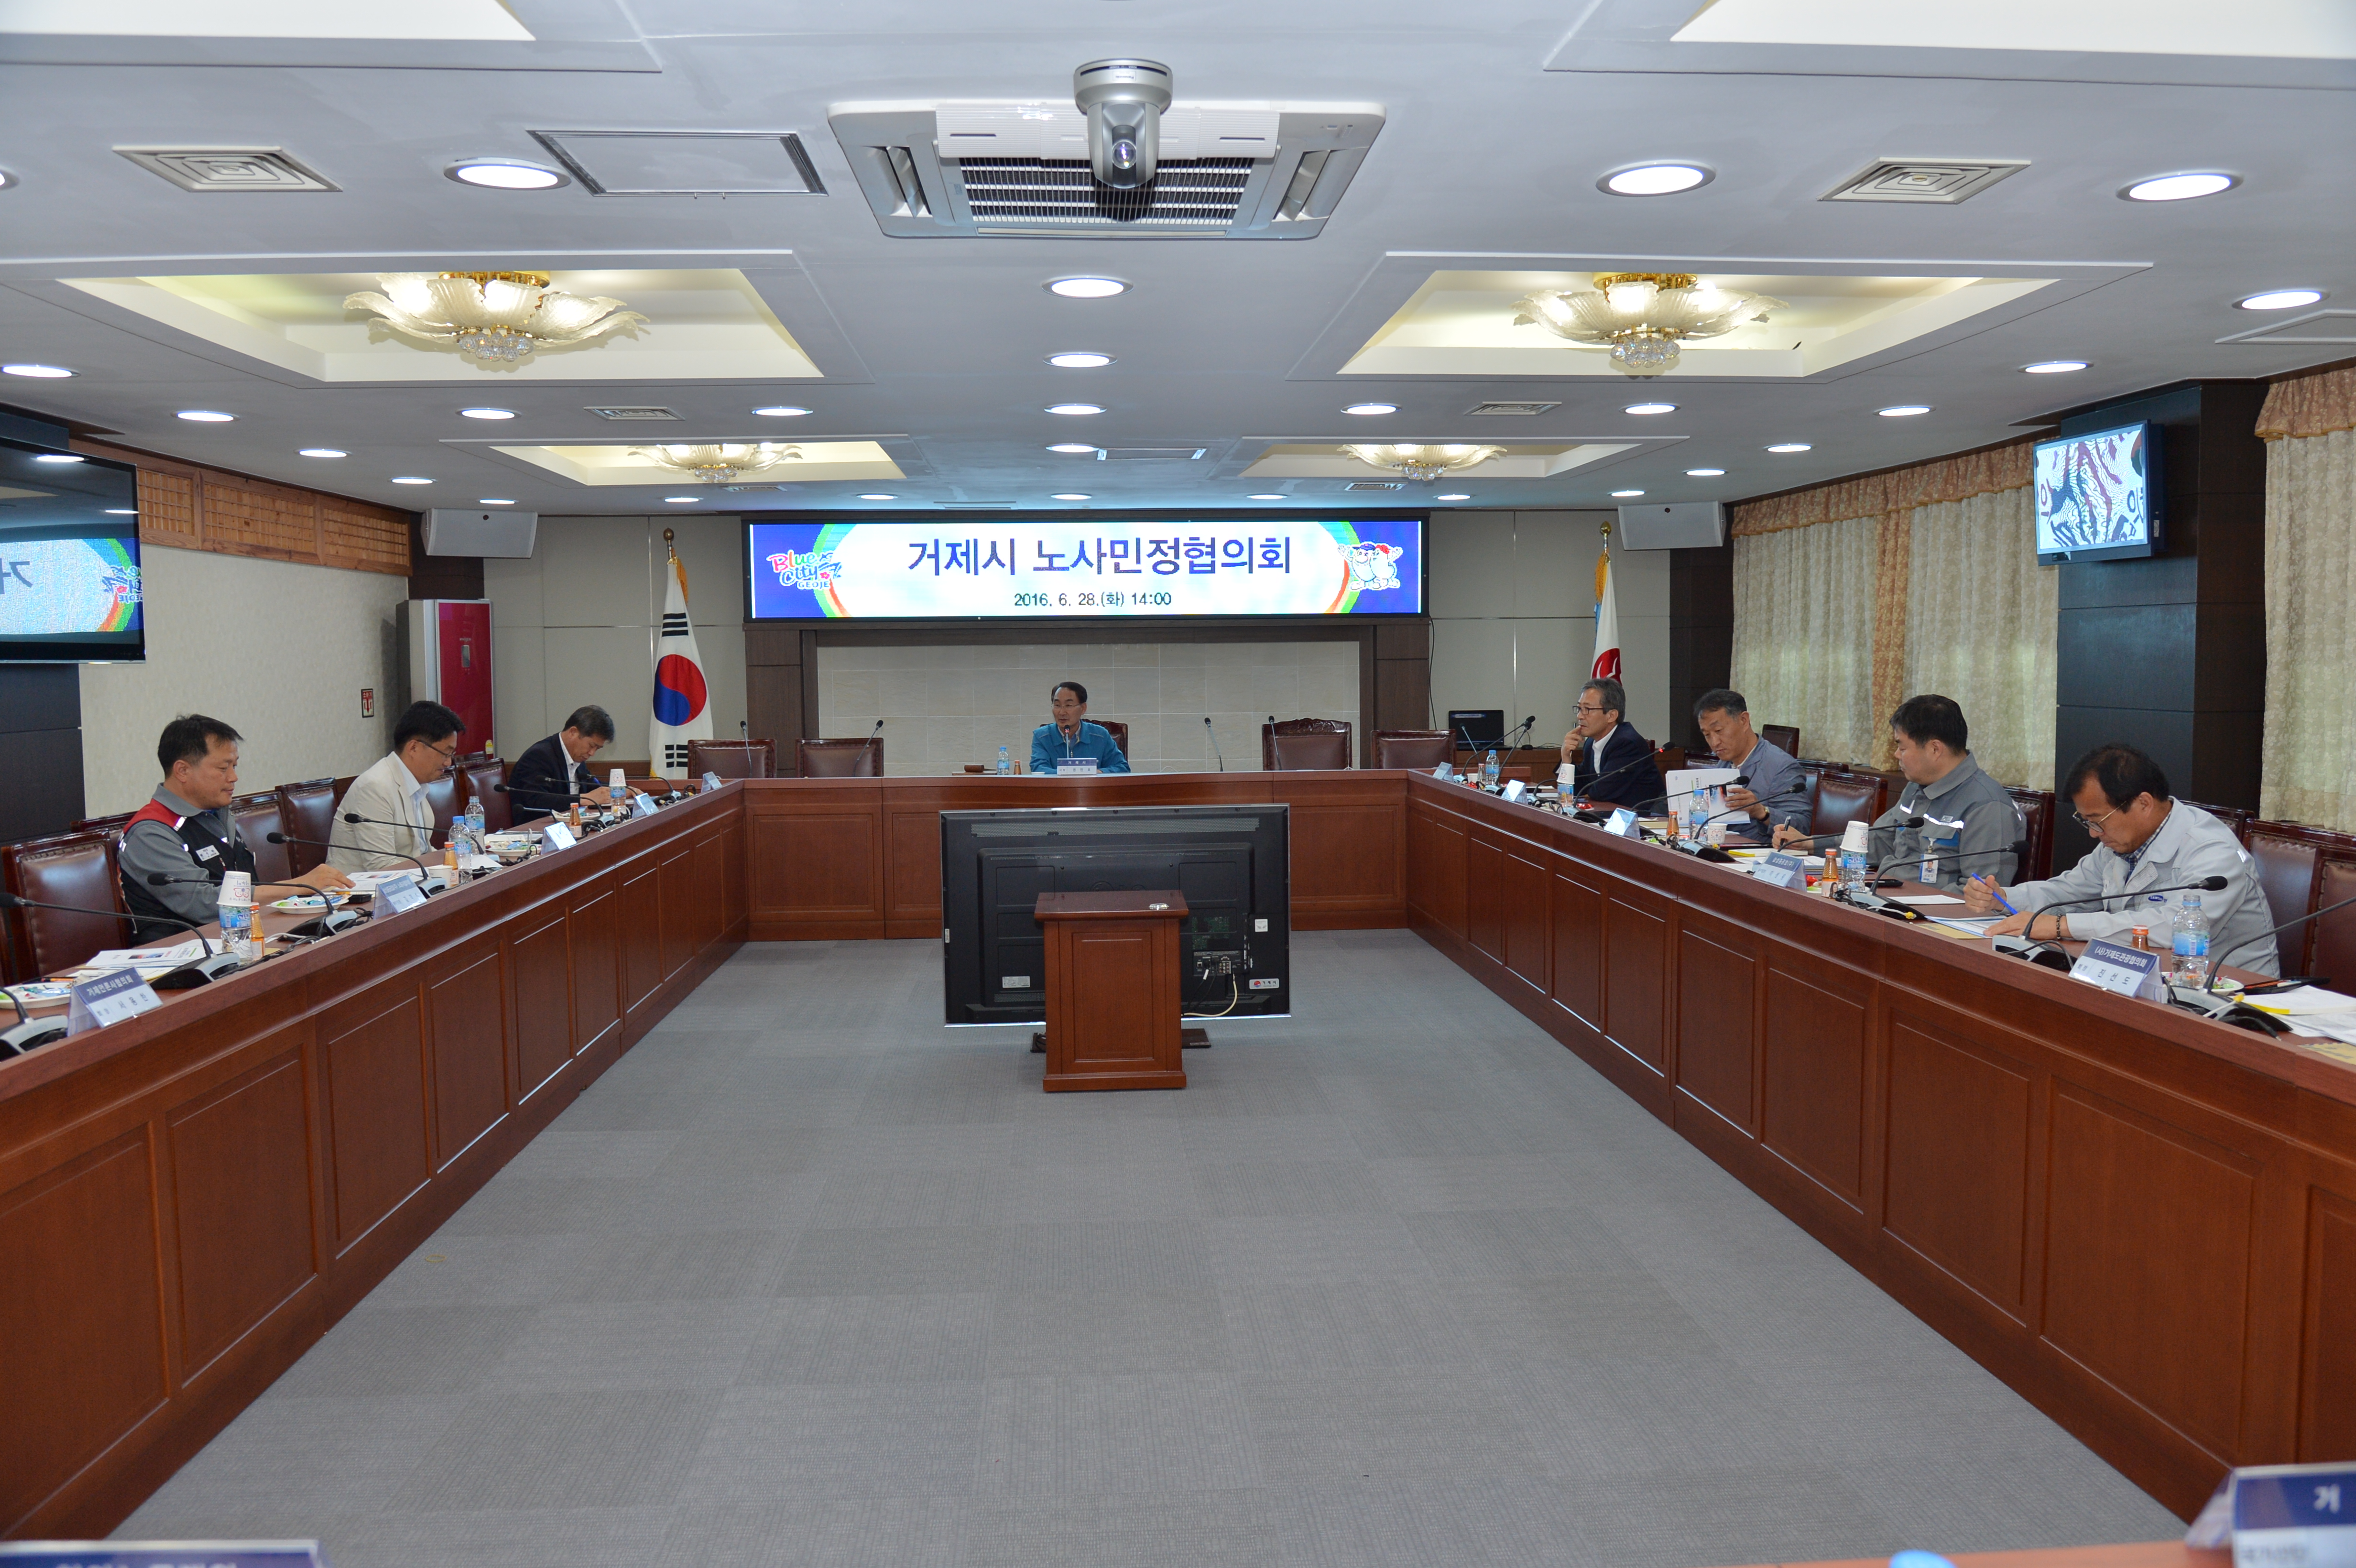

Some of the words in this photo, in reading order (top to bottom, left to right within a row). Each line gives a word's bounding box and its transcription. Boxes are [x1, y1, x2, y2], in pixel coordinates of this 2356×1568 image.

[768, 550, 818, 572] Blue
[908, 538, 1015, 576] 거제시
[1033, 537, 1290, 575] 노사민정협의회
[781, 565, 818, 585] City
[798, 581, 829, 589] GEOJE
[1014, 593, 1052, 607] 2016.
[1058, 593, 1071, 607] 6.
[1131, 592, 1172, 605] 14:00
[2094, 946, 2148, 968] (사)거제도관광협의회
[87, 974, 134, 996] 거제언론사협의회
